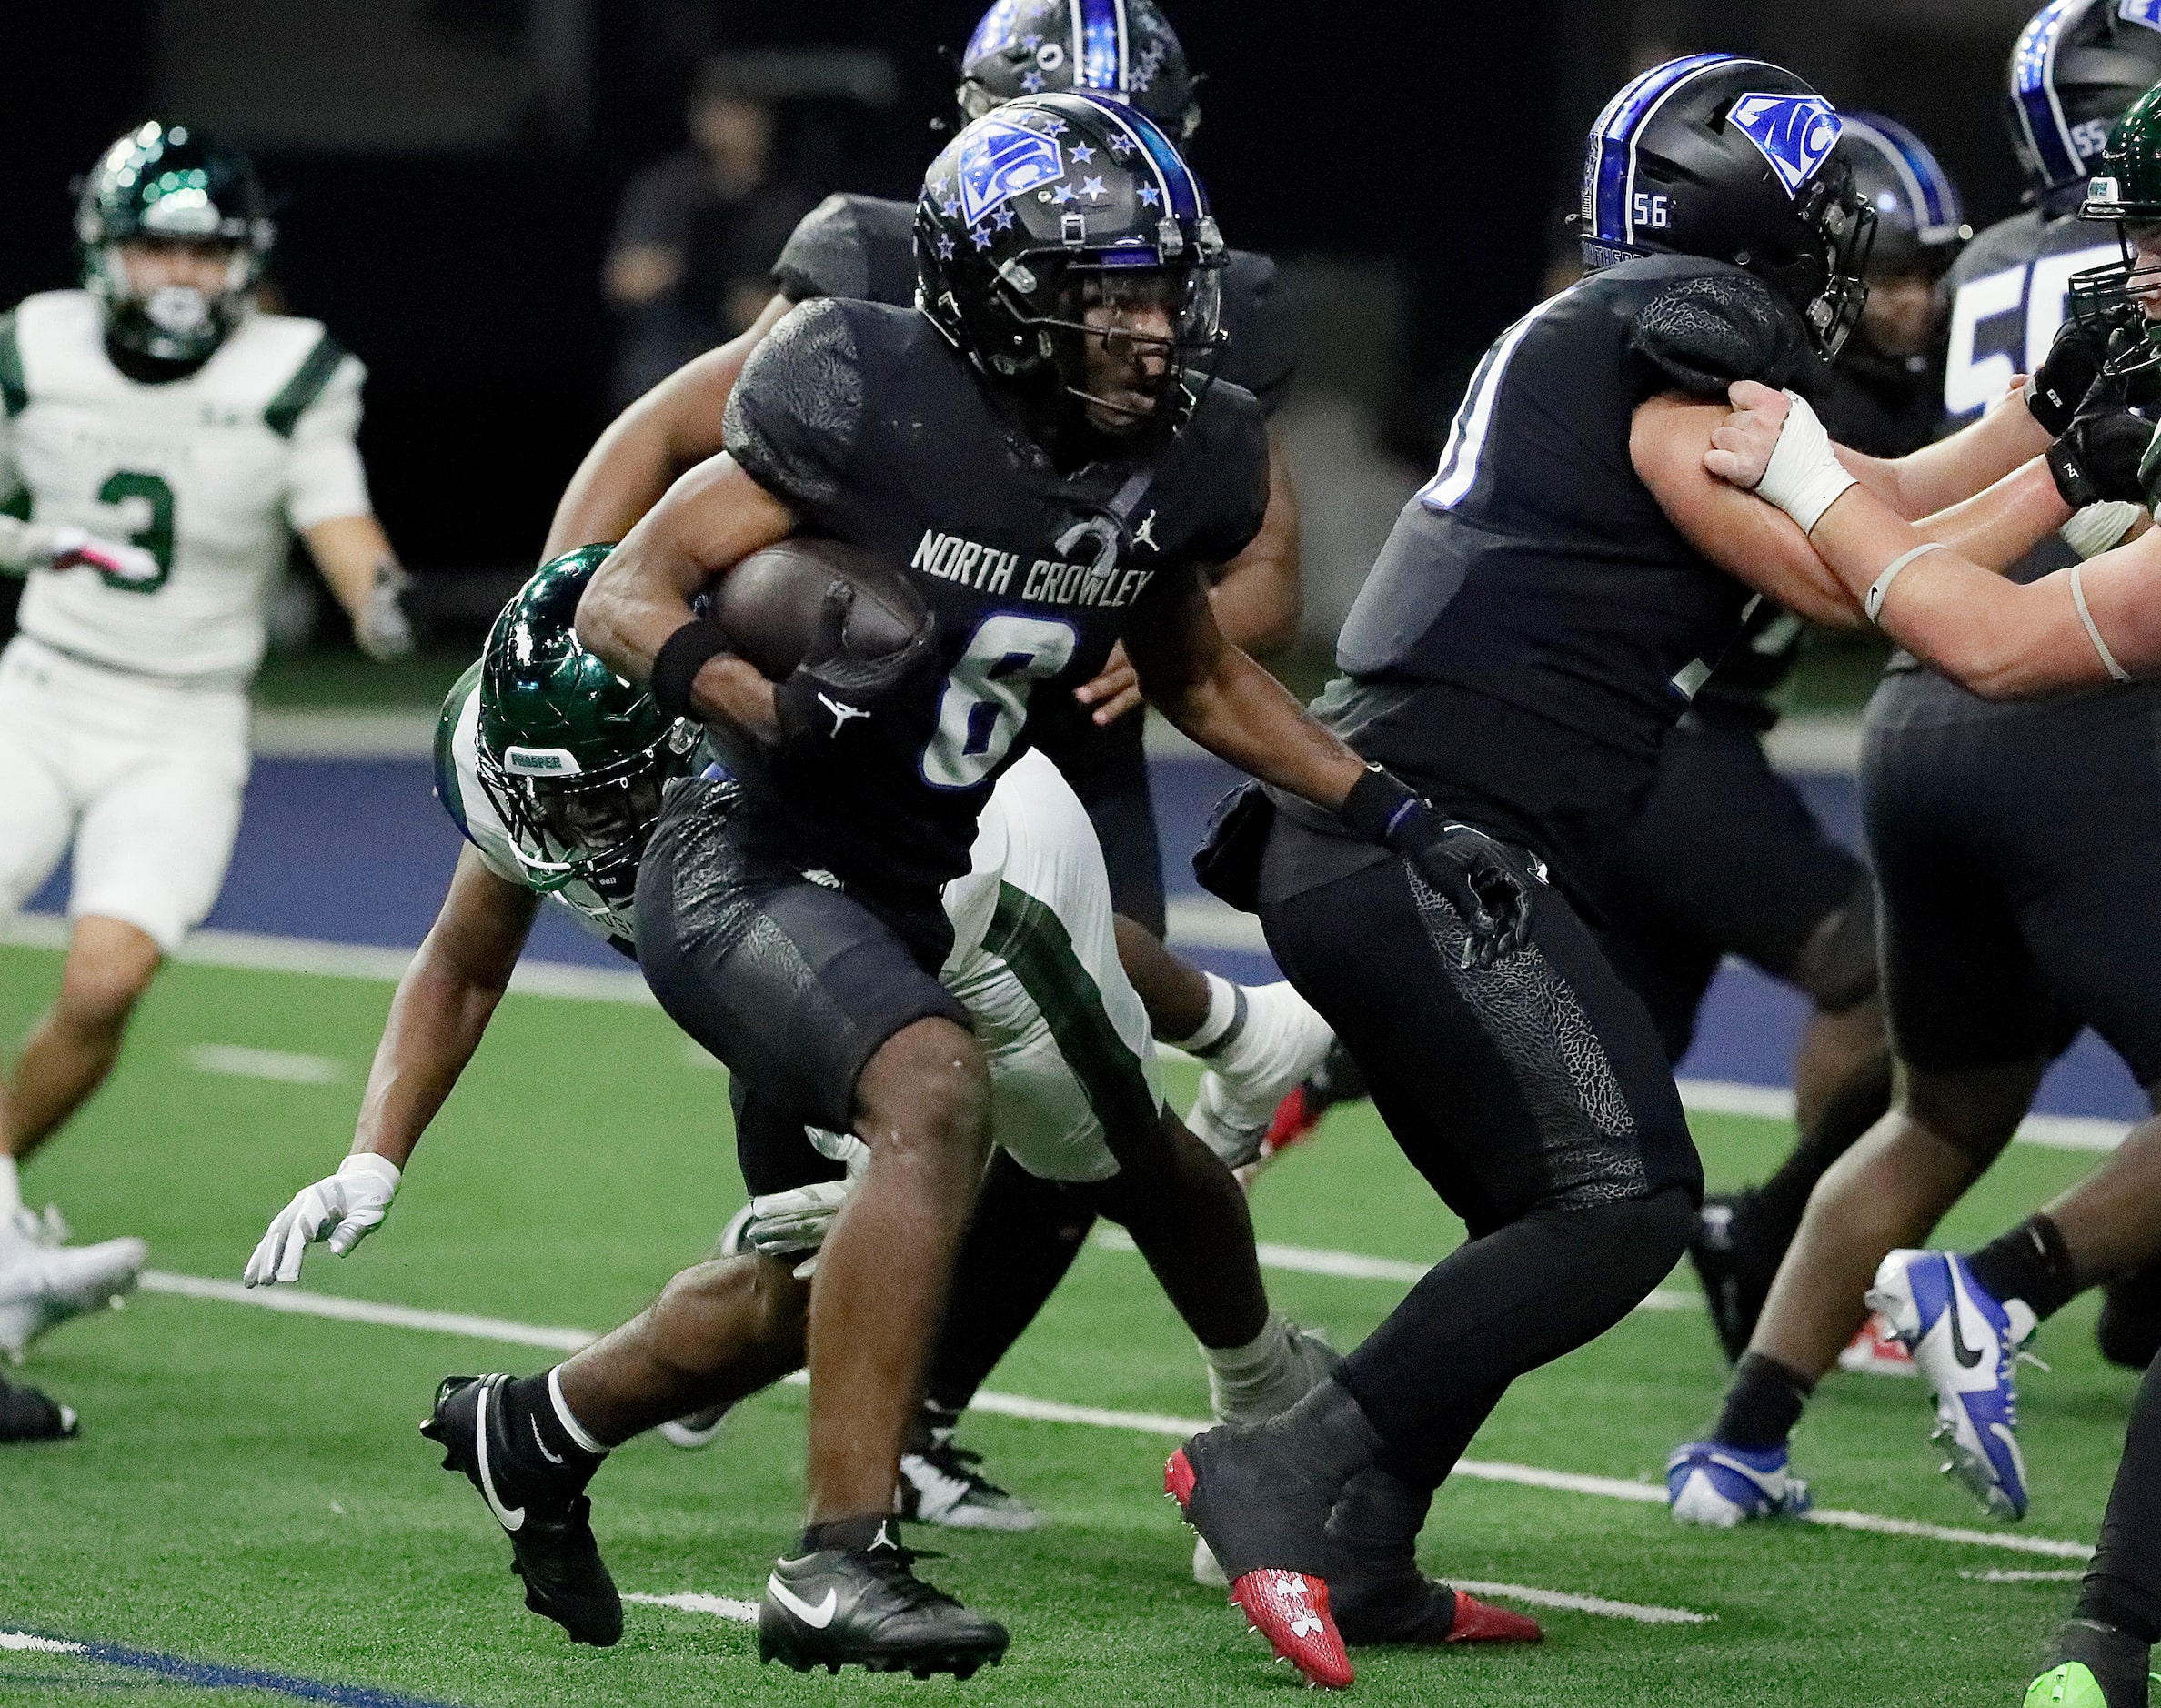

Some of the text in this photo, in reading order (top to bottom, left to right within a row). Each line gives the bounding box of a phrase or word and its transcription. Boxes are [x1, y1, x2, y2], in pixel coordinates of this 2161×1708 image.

[1634, 193, 1668, 227] 56
[98, 469, 172, 596] 3
[910, 528, 1155, 607] NORTH CROWLEY
[920, 612, 1078, 789] 6
[510, 752, 562, 769] PROSPER
